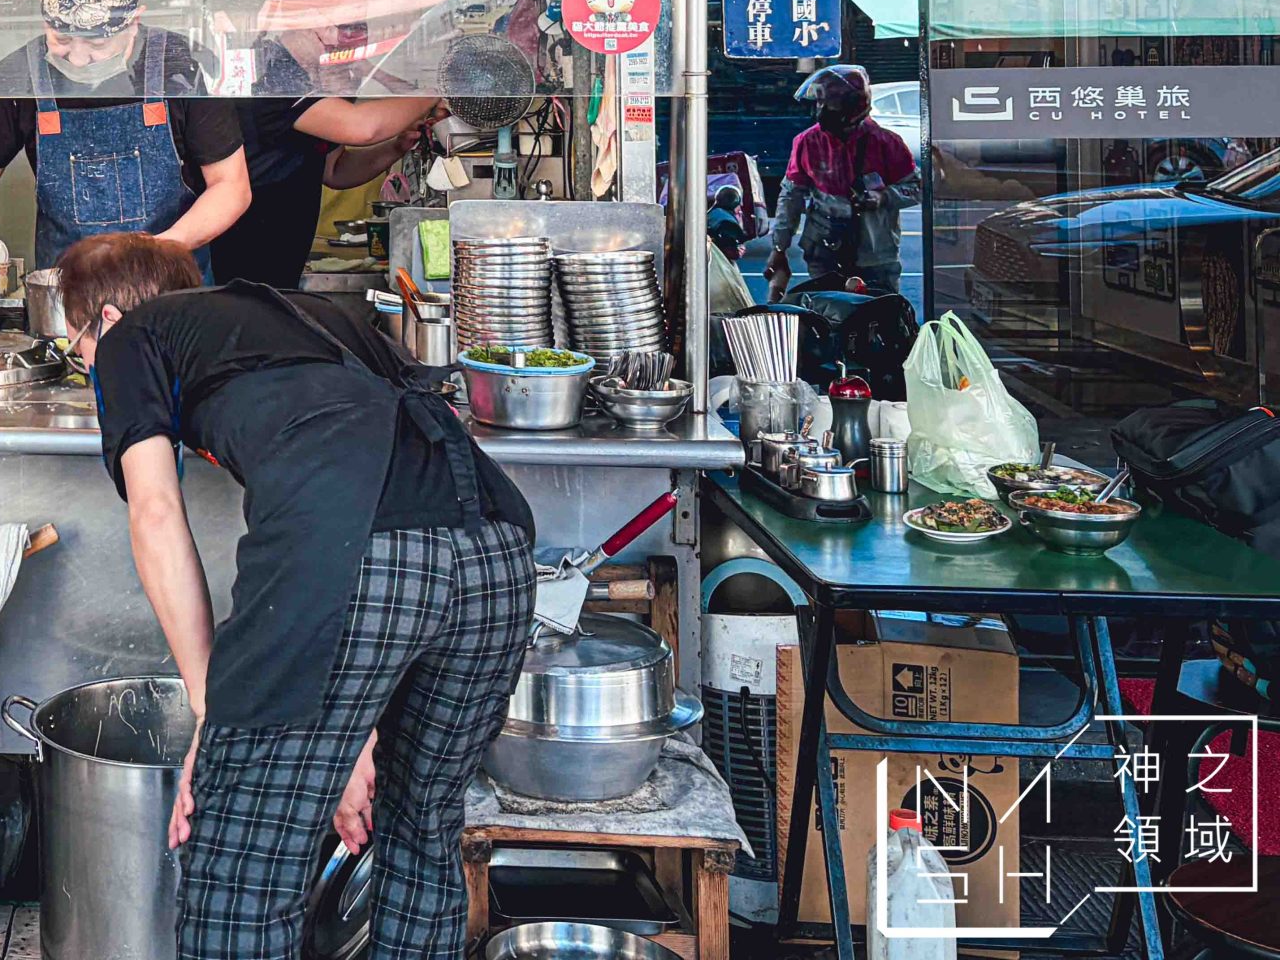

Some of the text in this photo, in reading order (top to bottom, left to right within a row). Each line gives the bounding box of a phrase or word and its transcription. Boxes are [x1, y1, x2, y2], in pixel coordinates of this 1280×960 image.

[1029, 85, 1191, 109] 西悠巢旅
[1029, 110, 1191, 121] CU HOTEL
[929, 704, 938, 721] NET
[923, 794, 939, 842] 味之素
